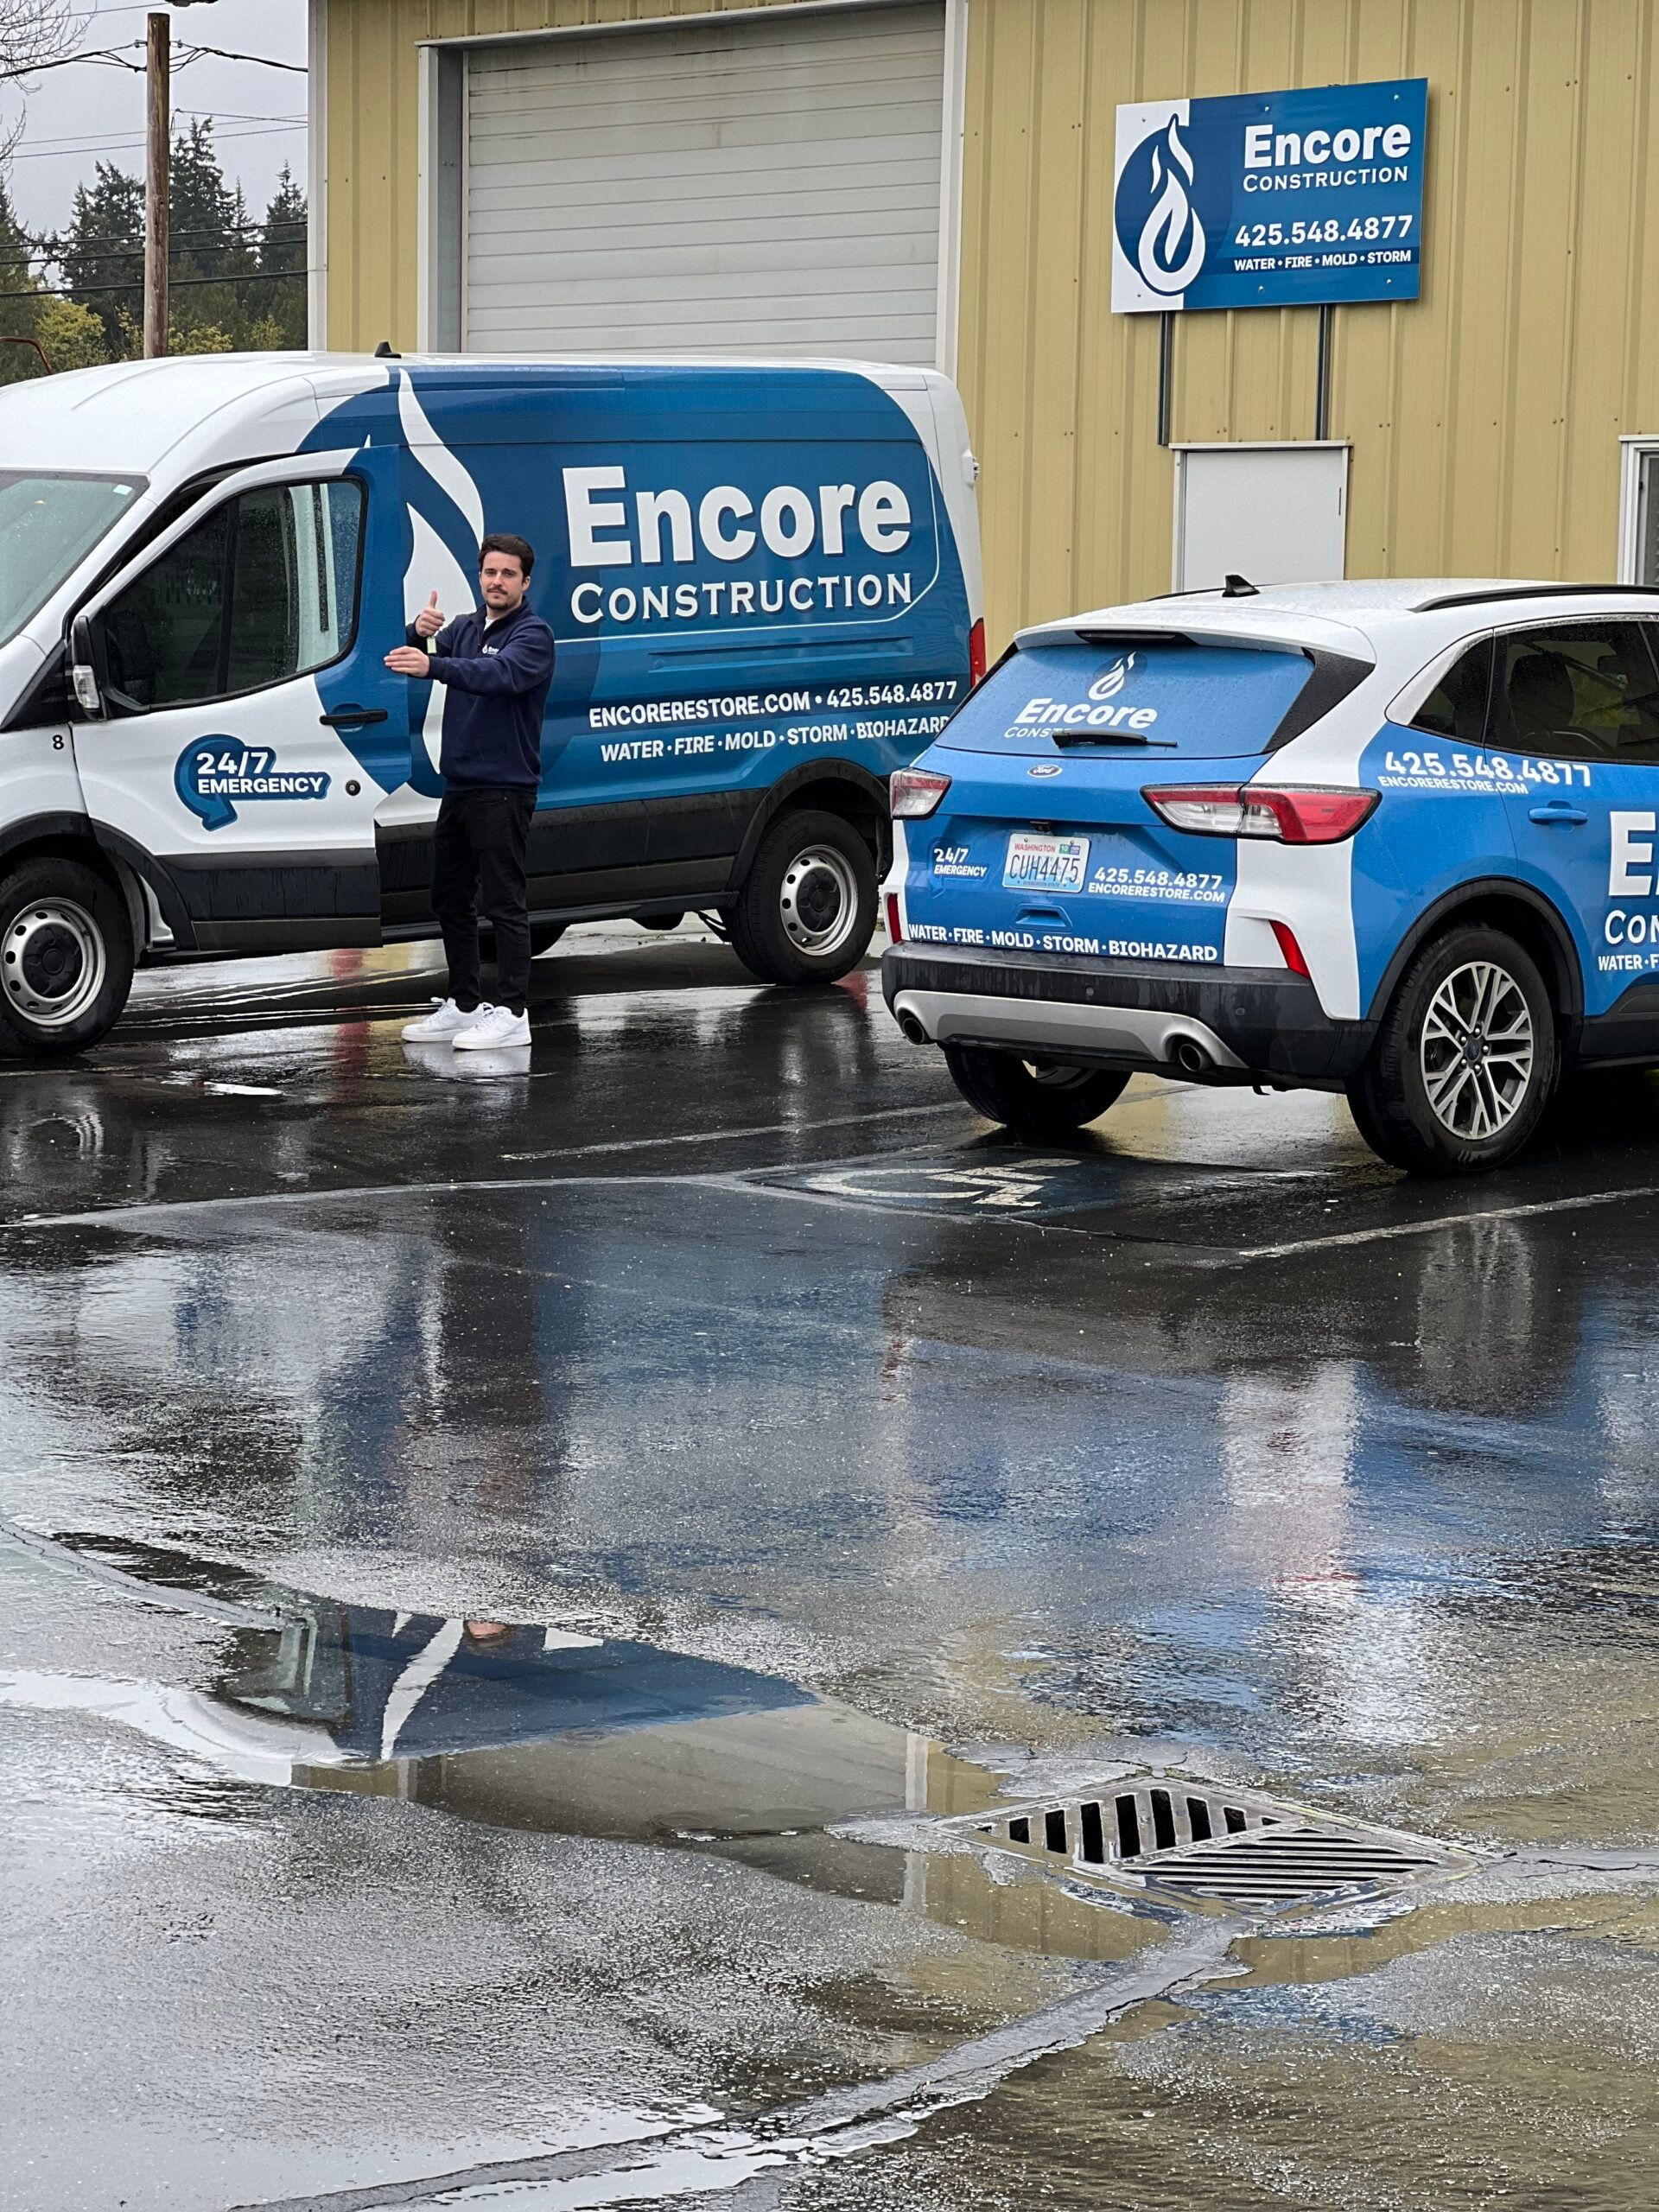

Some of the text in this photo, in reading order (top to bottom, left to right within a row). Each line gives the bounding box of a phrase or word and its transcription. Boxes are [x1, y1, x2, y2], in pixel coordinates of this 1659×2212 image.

[1244, 124, 1411, 168] Encore
[1243, 165, 1408, 192] CONSTRUCTION
[1236, 215, 1413, 247] 425.548.4877
[1235, 250, 1412, 271] WATER FIRE MOLD STORM
[563, 466, 911, 567] Encore
[571, 573, 912, 624] CONSTRUCTION
[589, 681, 957, 728] ENCORERESTORE.COM 425.548.4877
[1014, 697, 1158, 728] Encore
[52, 734, 65, 750] 8
[601, 741, 664, 762] WATER
[675, 734, 715, 756] FIRE
[725, 730, 775, 750] MOLD
[787, 723, 848, 745] STORM
[197, 752, 269, 776] 24/7
[1385, 751, 1591, 787] 425.548.4877
[198, 777, 323, 794] EMERGENCY
[1378, 776, 1529, 794] ENCORERESTORE.COM
[934, 848, 969, 862] 24/7
[1014, 843, 1056, 853] WASHINGTON
[1609, 811, 1659, 896] E
[934, 864, 987, 877] EMERGENCY
[1009, 855, 1080, 882] CUH4475
[1095, 867, 1223, 890] 425.548.4877
[1088, 881, 1225, 903] ENCORERESTORE.COM
[908, 924, 1217, 961] WATER FIRE MOLD STORM BIOHAZARD
[1599, 954, 1643, 970] WATER
